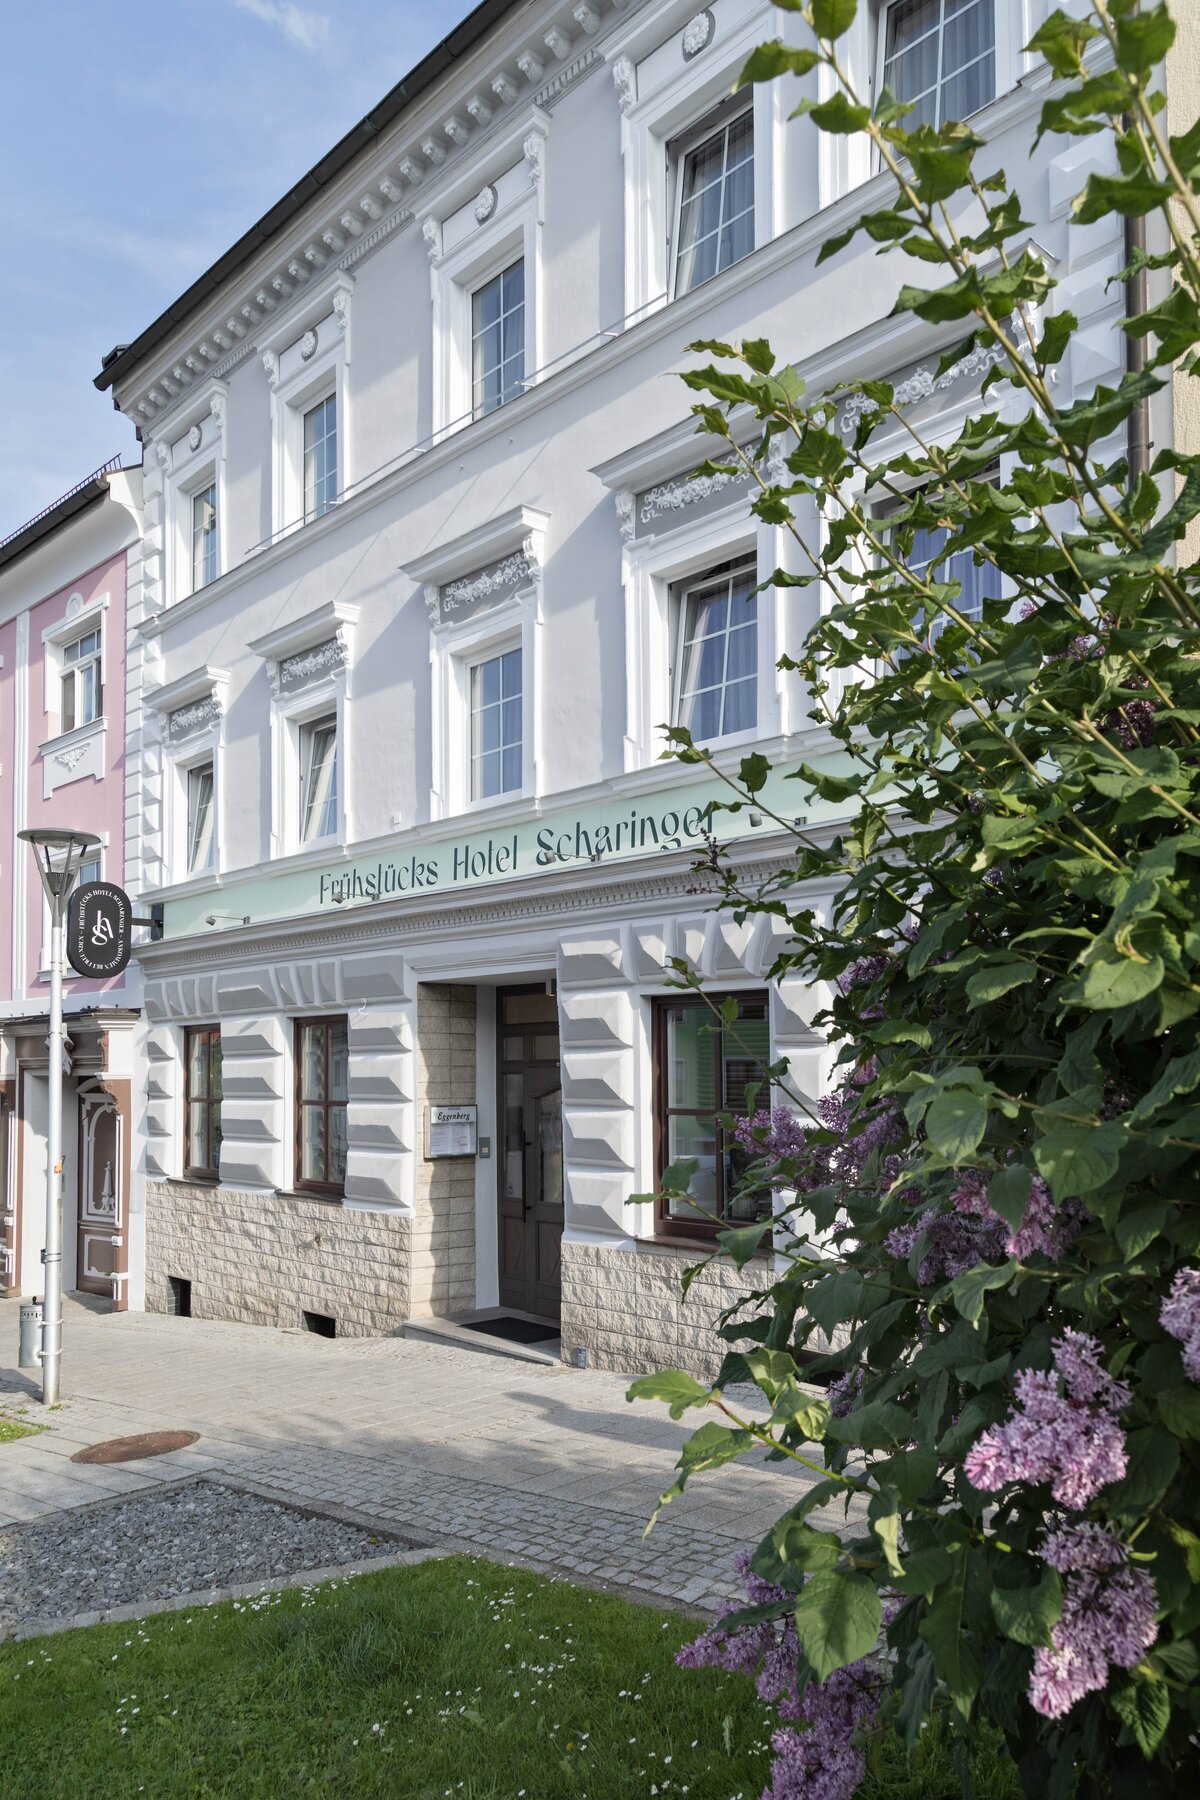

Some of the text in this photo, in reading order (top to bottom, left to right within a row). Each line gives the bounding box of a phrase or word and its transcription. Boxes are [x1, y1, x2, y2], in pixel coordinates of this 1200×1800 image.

[320, 856, 439, 904] Frühstücks
[453, 835, 518, 881] Hotel
[92, 889, 113, 897] HOTEL
[112, 894, 125, 934] SCHARINGER
[437, 1111, 470, 1121] Eggenberg
